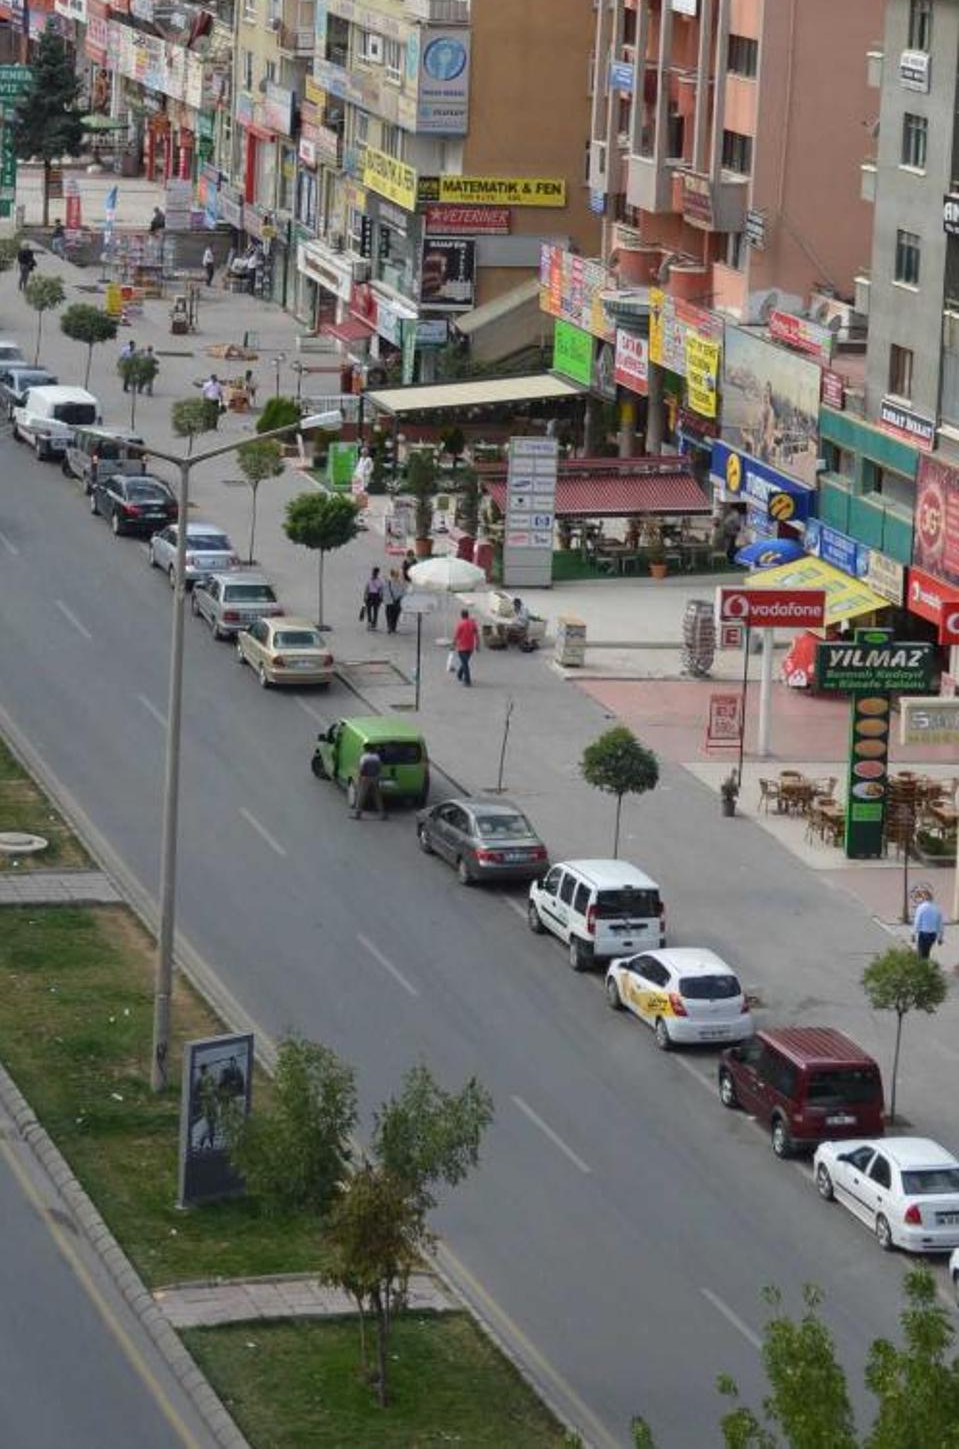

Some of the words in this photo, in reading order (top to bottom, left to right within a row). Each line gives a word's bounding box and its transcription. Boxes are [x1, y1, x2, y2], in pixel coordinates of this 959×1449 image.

[522, 181, 532, 193] &
[536, 182, 562, 195] FEN
[751, 602, 822, 617] vodafone
[828, 649, 923, 667] YILMAZ
